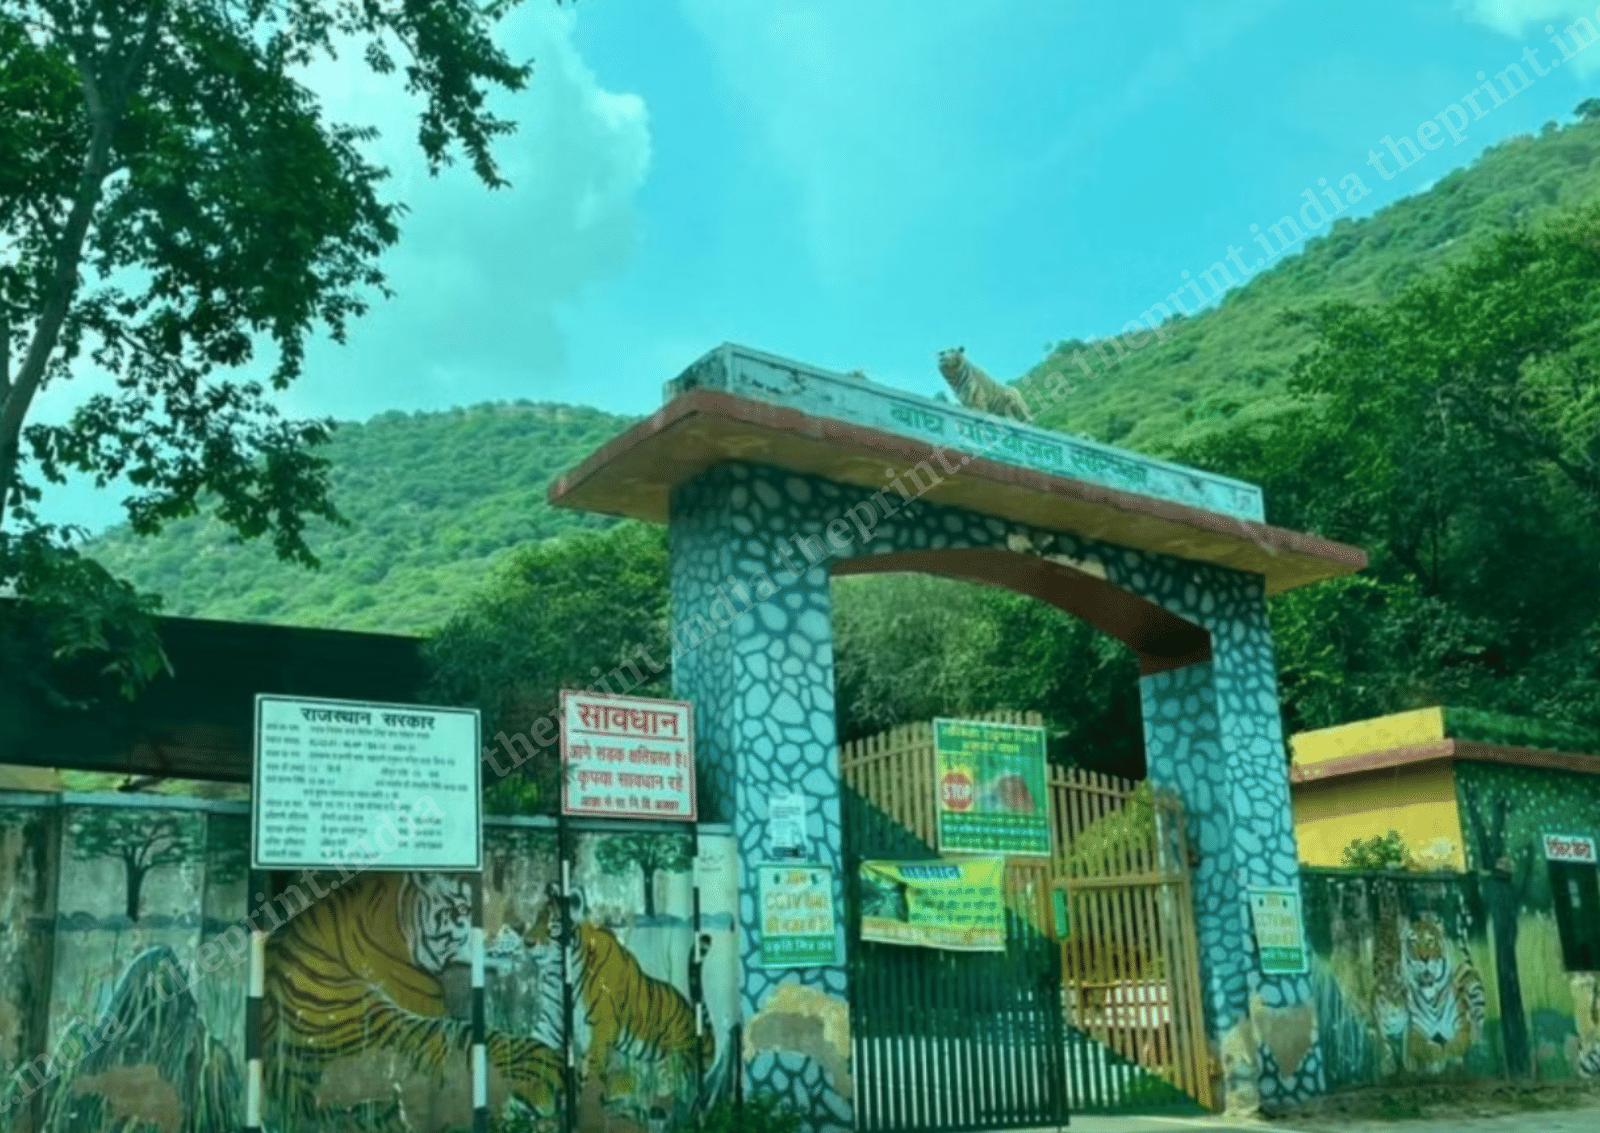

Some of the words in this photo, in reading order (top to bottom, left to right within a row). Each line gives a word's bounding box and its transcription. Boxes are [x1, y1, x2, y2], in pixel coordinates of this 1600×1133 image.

[300, 707, 372, 726] राजस्थान
[381, 711, 436, 730] सरकार
[575, 702, 679, 736] सावधान
